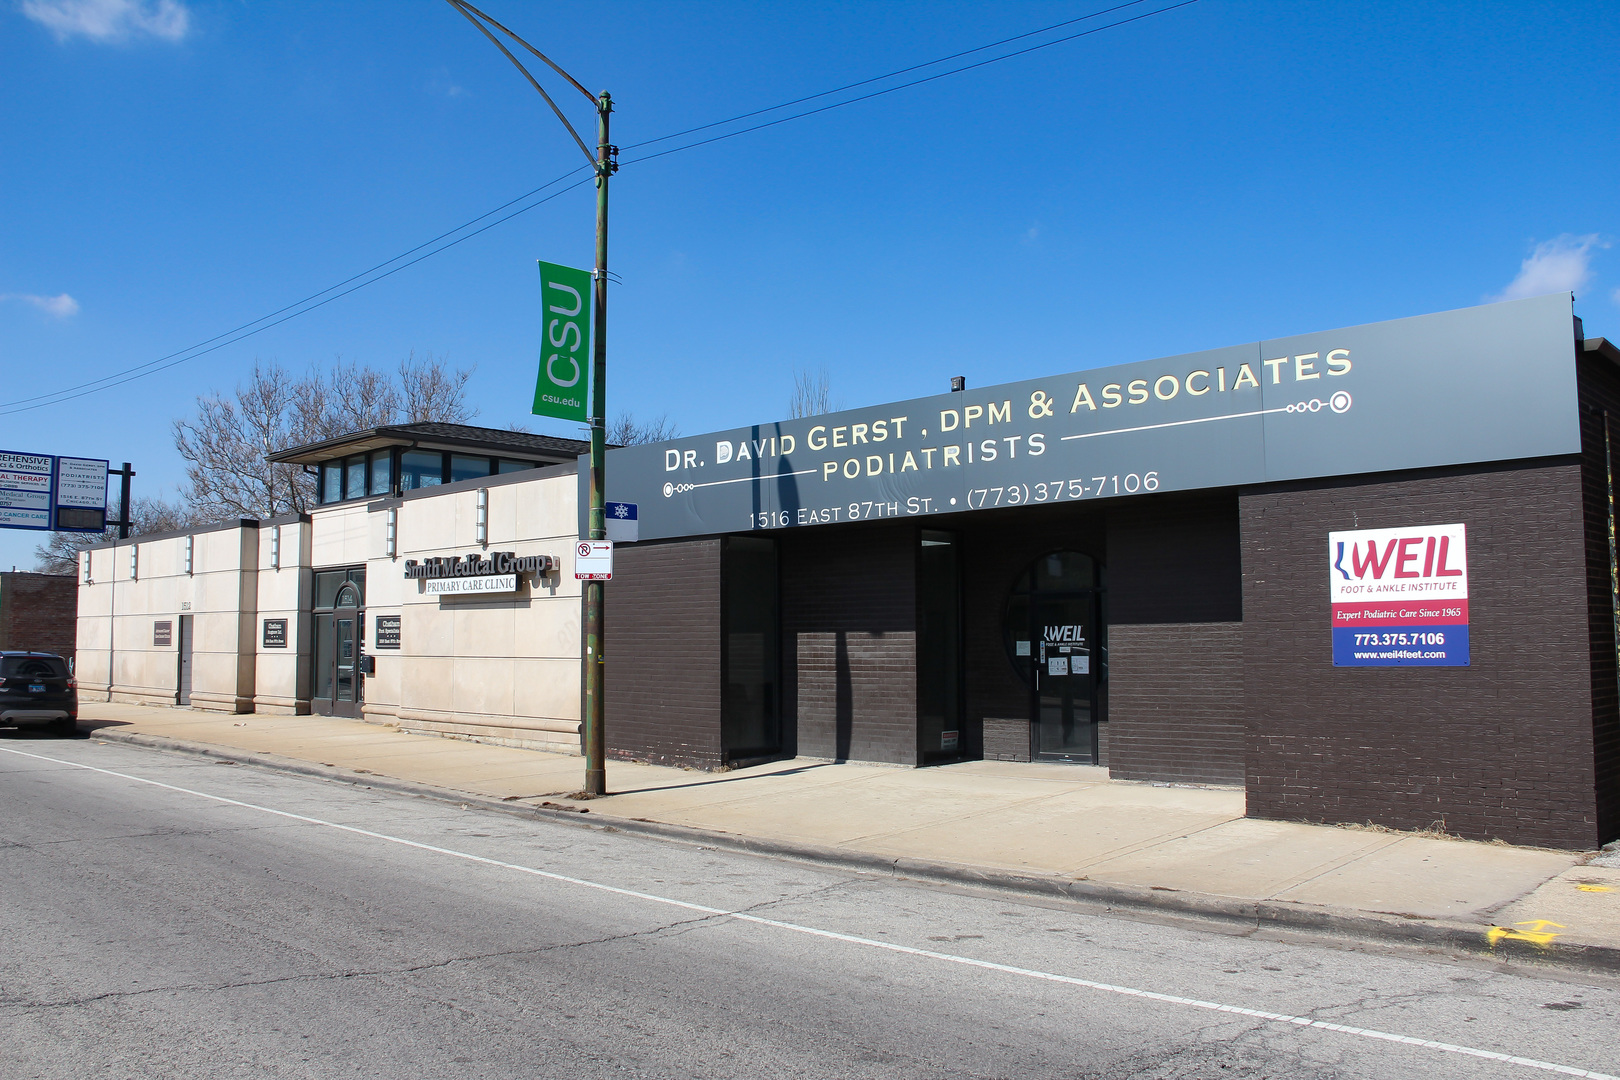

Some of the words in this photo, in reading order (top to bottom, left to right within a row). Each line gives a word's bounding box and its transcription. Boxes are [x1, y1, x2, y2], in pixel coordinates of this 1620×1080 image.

[546, 282, 582, 388] CSU
[542, 394, 580, 408] csu.edu
[716, 435, 796, 464] DAVID
[940, 400, 1012, 432] DPM
[1028, 390, 1054, 419] &
[1070, 348, 1352, 413] ASSOCIATES
[823, 434, 1046, 482] PODIATRISTS
[750, 510, 790, 528] 1516
[798, 507, 842, 525] EAST
[848, 502, 898, 519] 87TH
[906, 497, 938, 514] ST.
[1352, 535, 1462, 580] WEIL
[405, 558, 440, 579] Smith
[443, 553, 495, 576] Medical
[498, 552, 546, 578] Group
[428, 579, 462, 592] PRIMARY
[463, 579, 484, 590] CARE
[485, 578, 515, 590] CLINIC
[1376, 584, 1406, 592] ANKLE
[1408, 582, 1458, 591] INSTITUTE
[1337, 610, 1361, 621] Expert
[1364, 609, 1397, 619] Podiatric
[1399, 608, 1417, 618] Care
[1419, 608, 1440, 617] Since
[1442, 608, 1461, 617] 1965
[1050, 626, 1085, 641] WEIL
[1354, 633, 1445, 646] 773.375.7106
[1354, 650, 1446, 659] www.weil4feet.com
